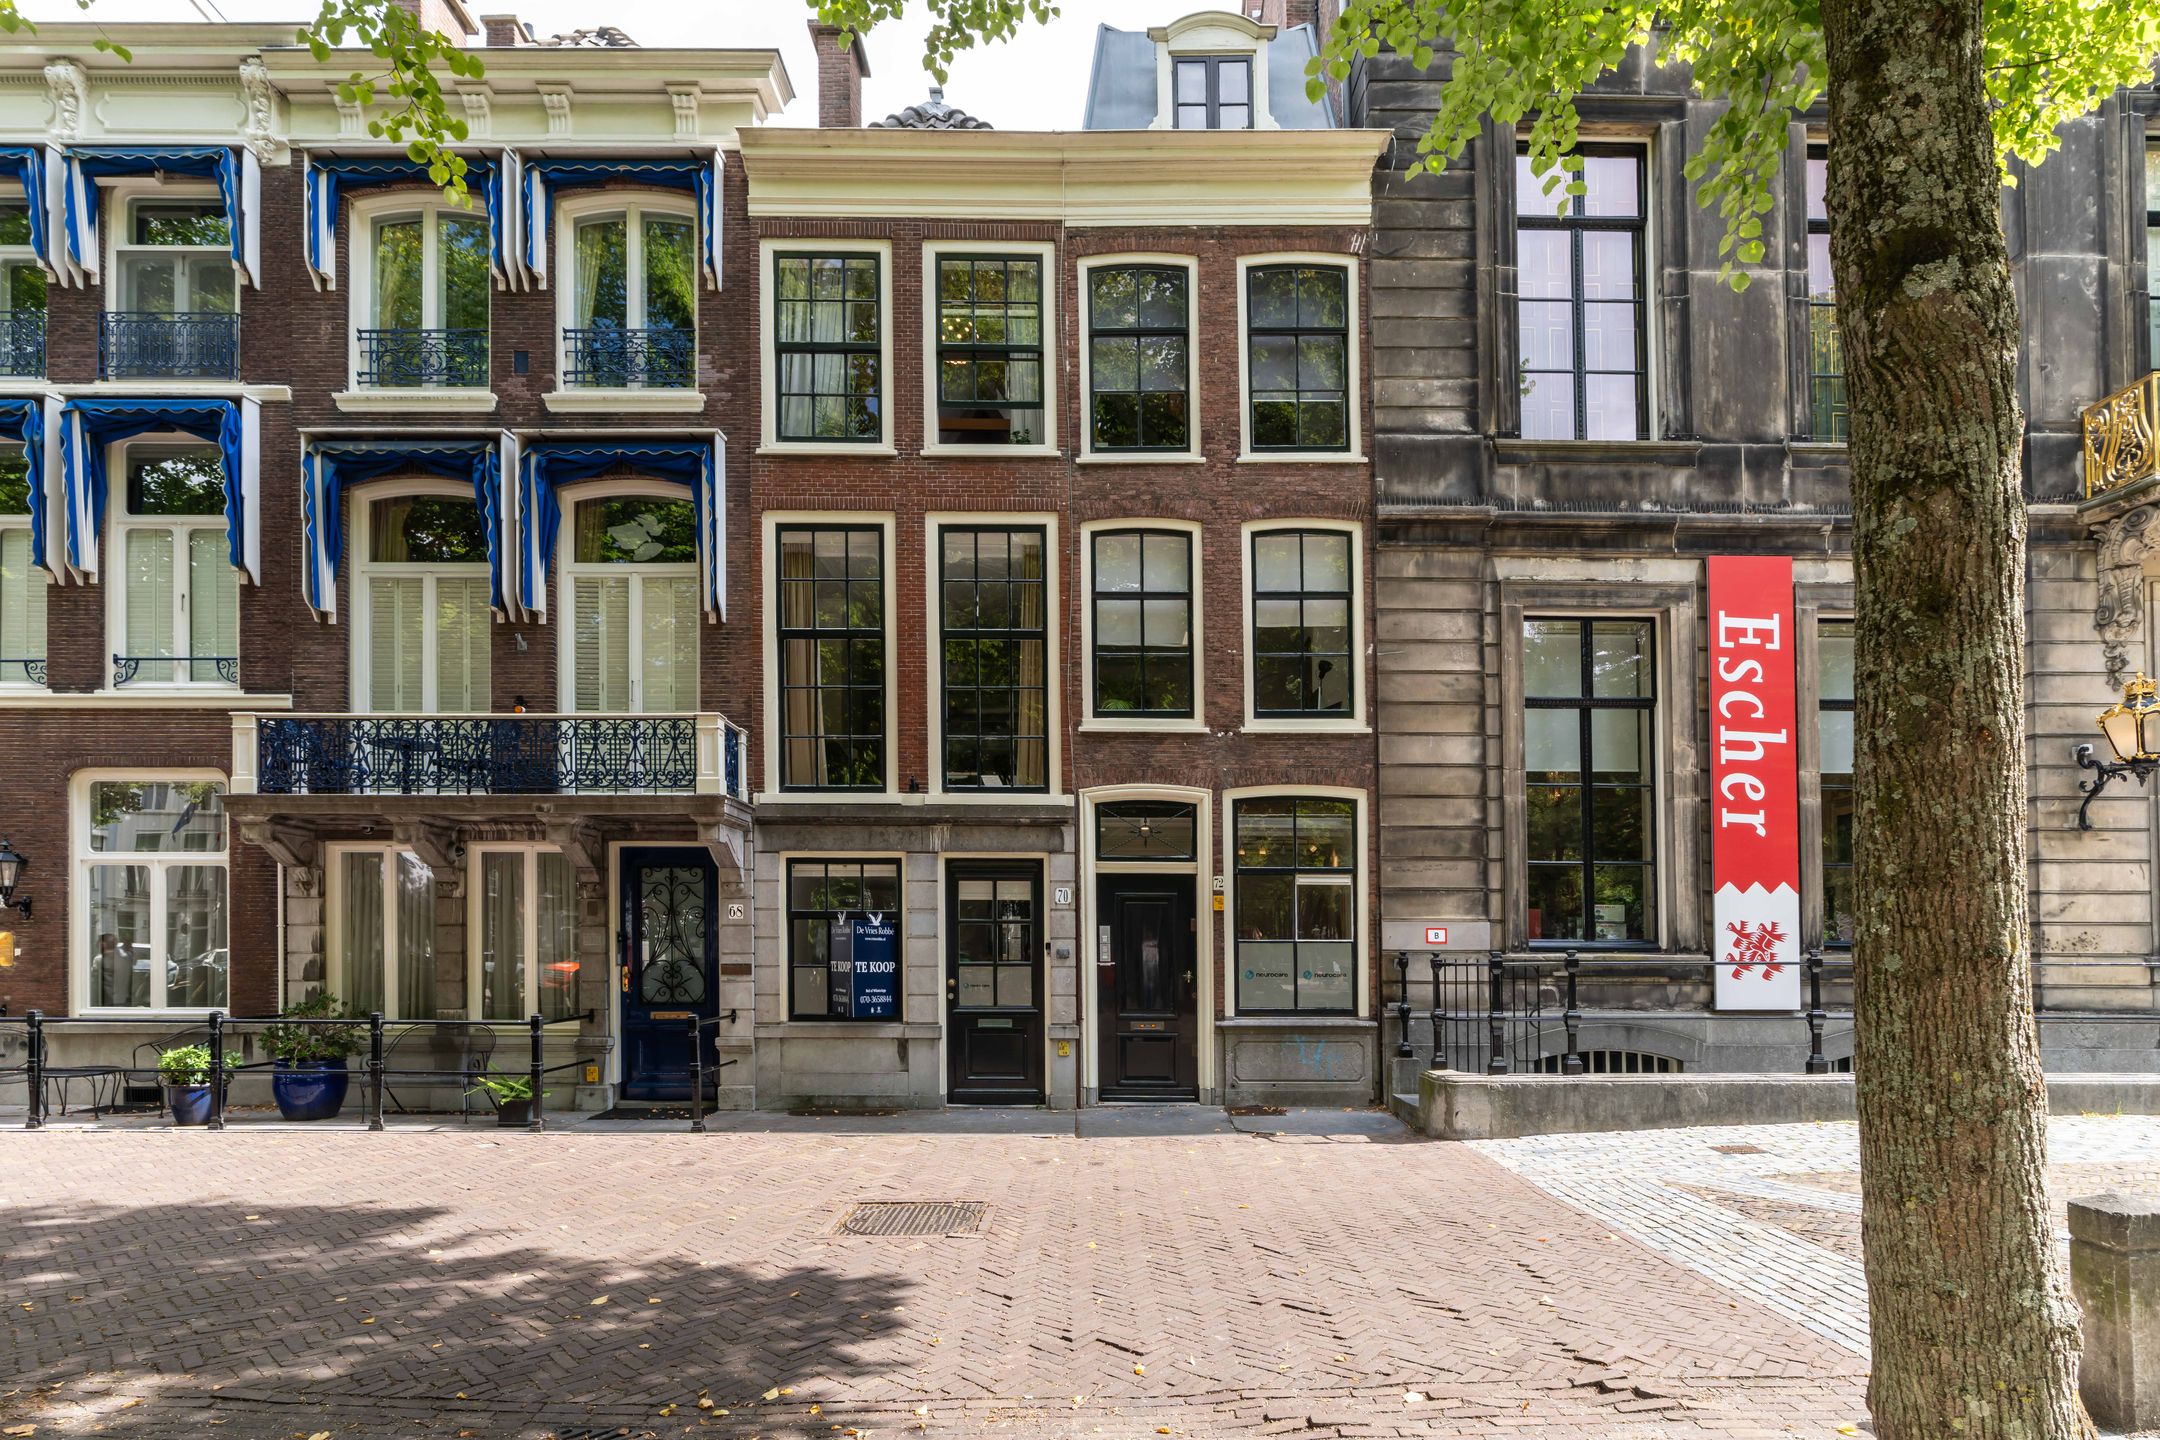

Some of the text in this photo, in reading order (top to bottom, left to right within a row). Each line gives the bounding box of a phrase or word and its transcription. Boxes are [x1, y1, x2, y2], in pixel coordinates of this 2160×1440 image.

[1718, 610, 1787, 837] Escher
[1214, 877, 1223, 888] 72
[1058, 889, 1069, 903] 70
[729, 906, 743, 917] 68
[856, 926, 864, 934] De
[865, 926, 878, 935] Vries
[1434, 931, 1440, 940] B
[830, 961, 851, 973] TE KOOP
[855, 961, 896, 973] TE KOOP
